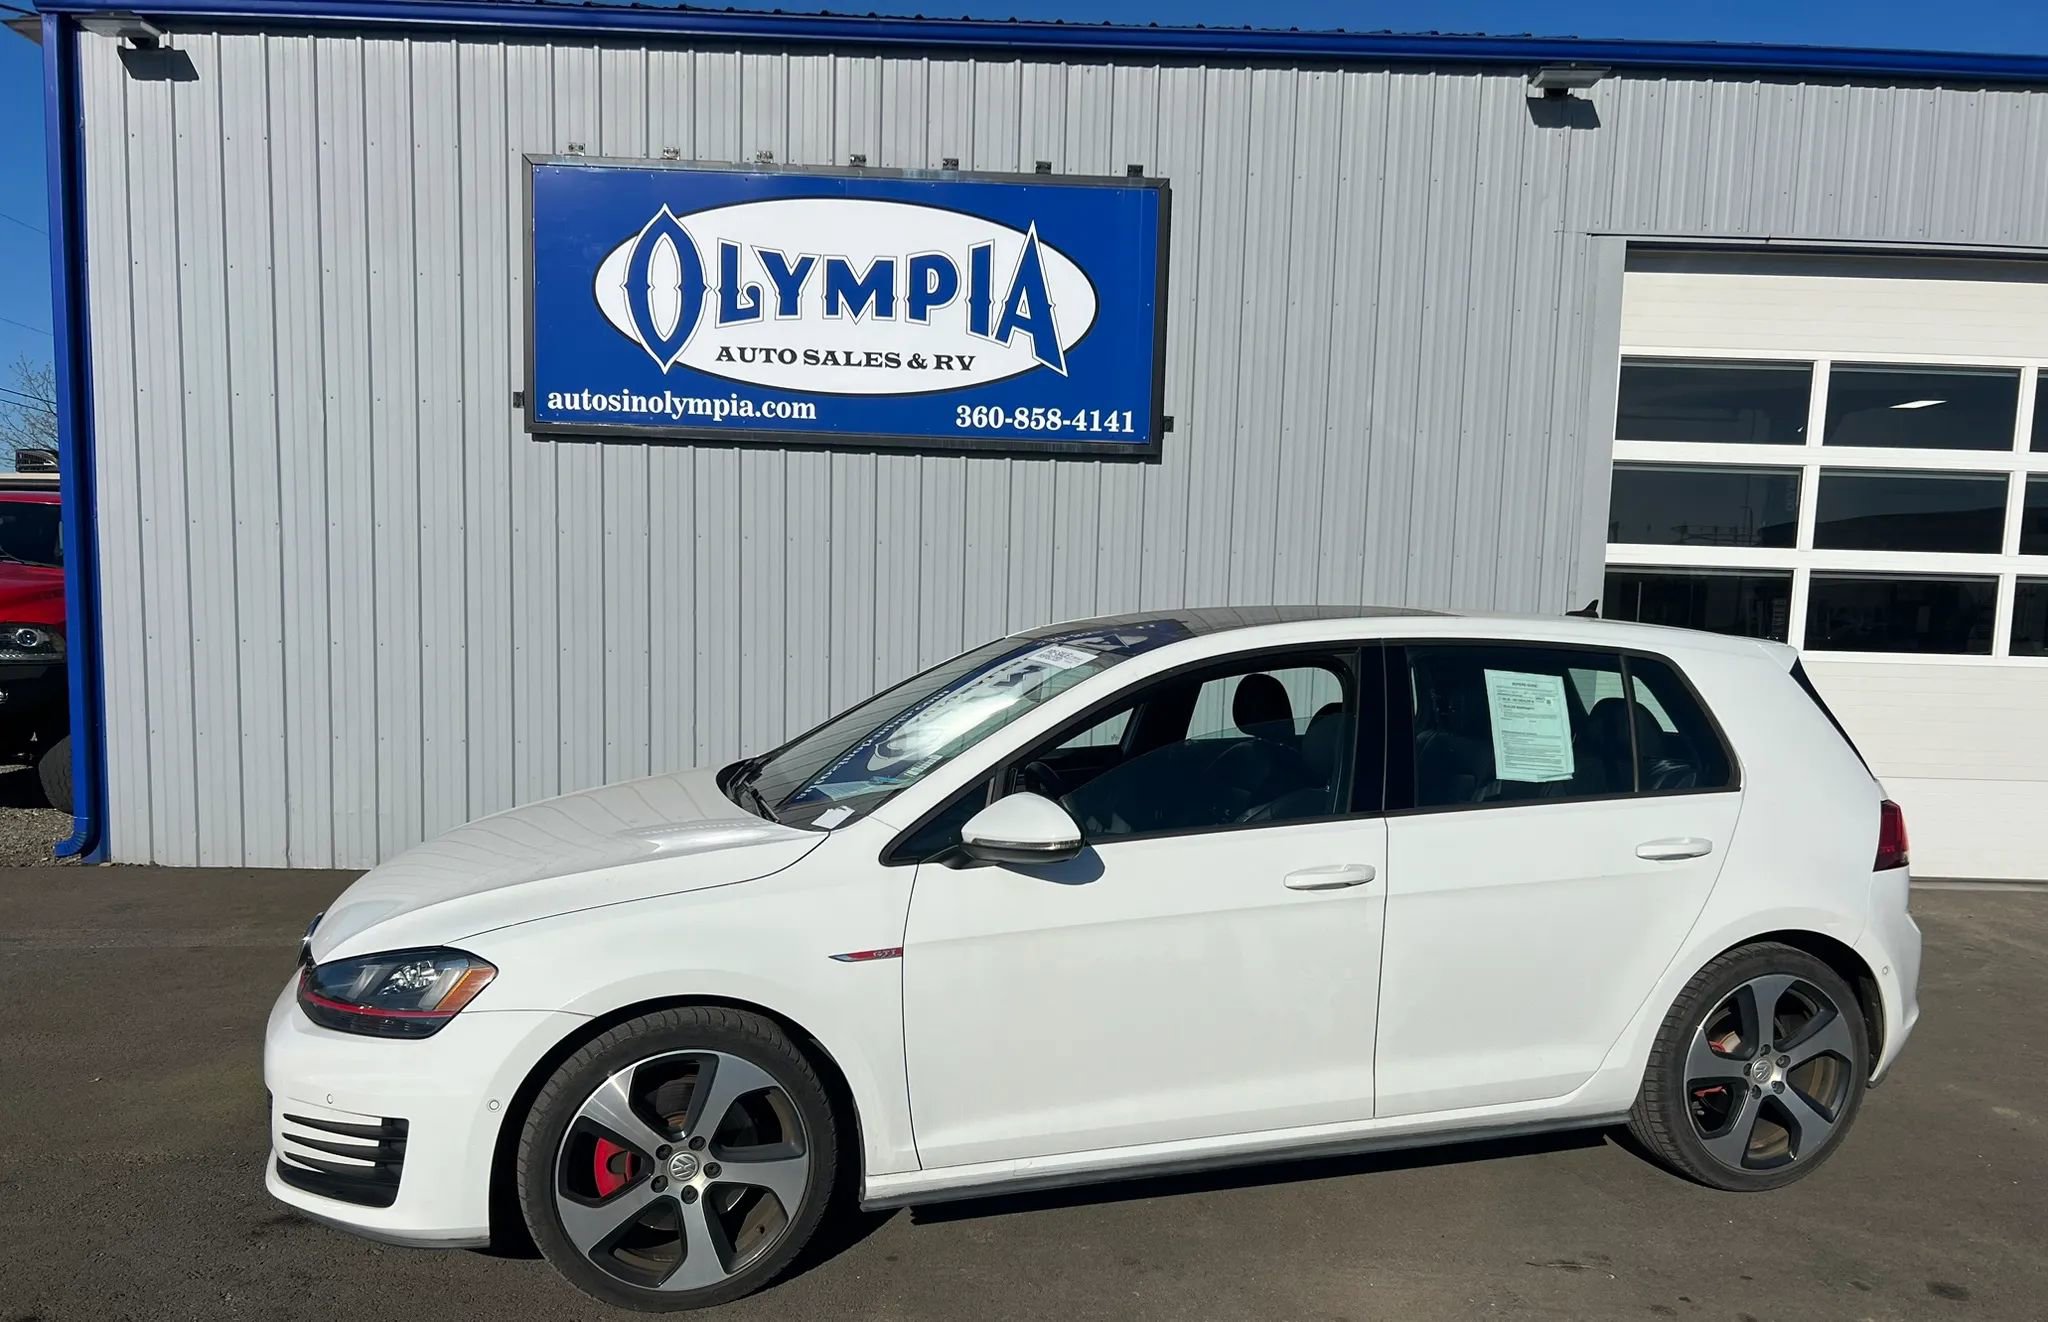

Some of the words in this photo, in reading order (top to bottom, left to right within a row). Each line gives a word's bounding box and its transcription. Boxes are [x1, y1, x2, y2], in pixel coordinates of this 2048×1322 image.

[621, 204, 1068, 377] OLYMPIA
[715, 346, 798, 365] AUTO
[803, 349, 902, 369] SALES
[906, 353, 928, 370] &
[933, 354, 976, 372] RV
[547, 387, 817, 422] autosinolympia.com
[955, 404, 1135, 434] 360-858-4141
